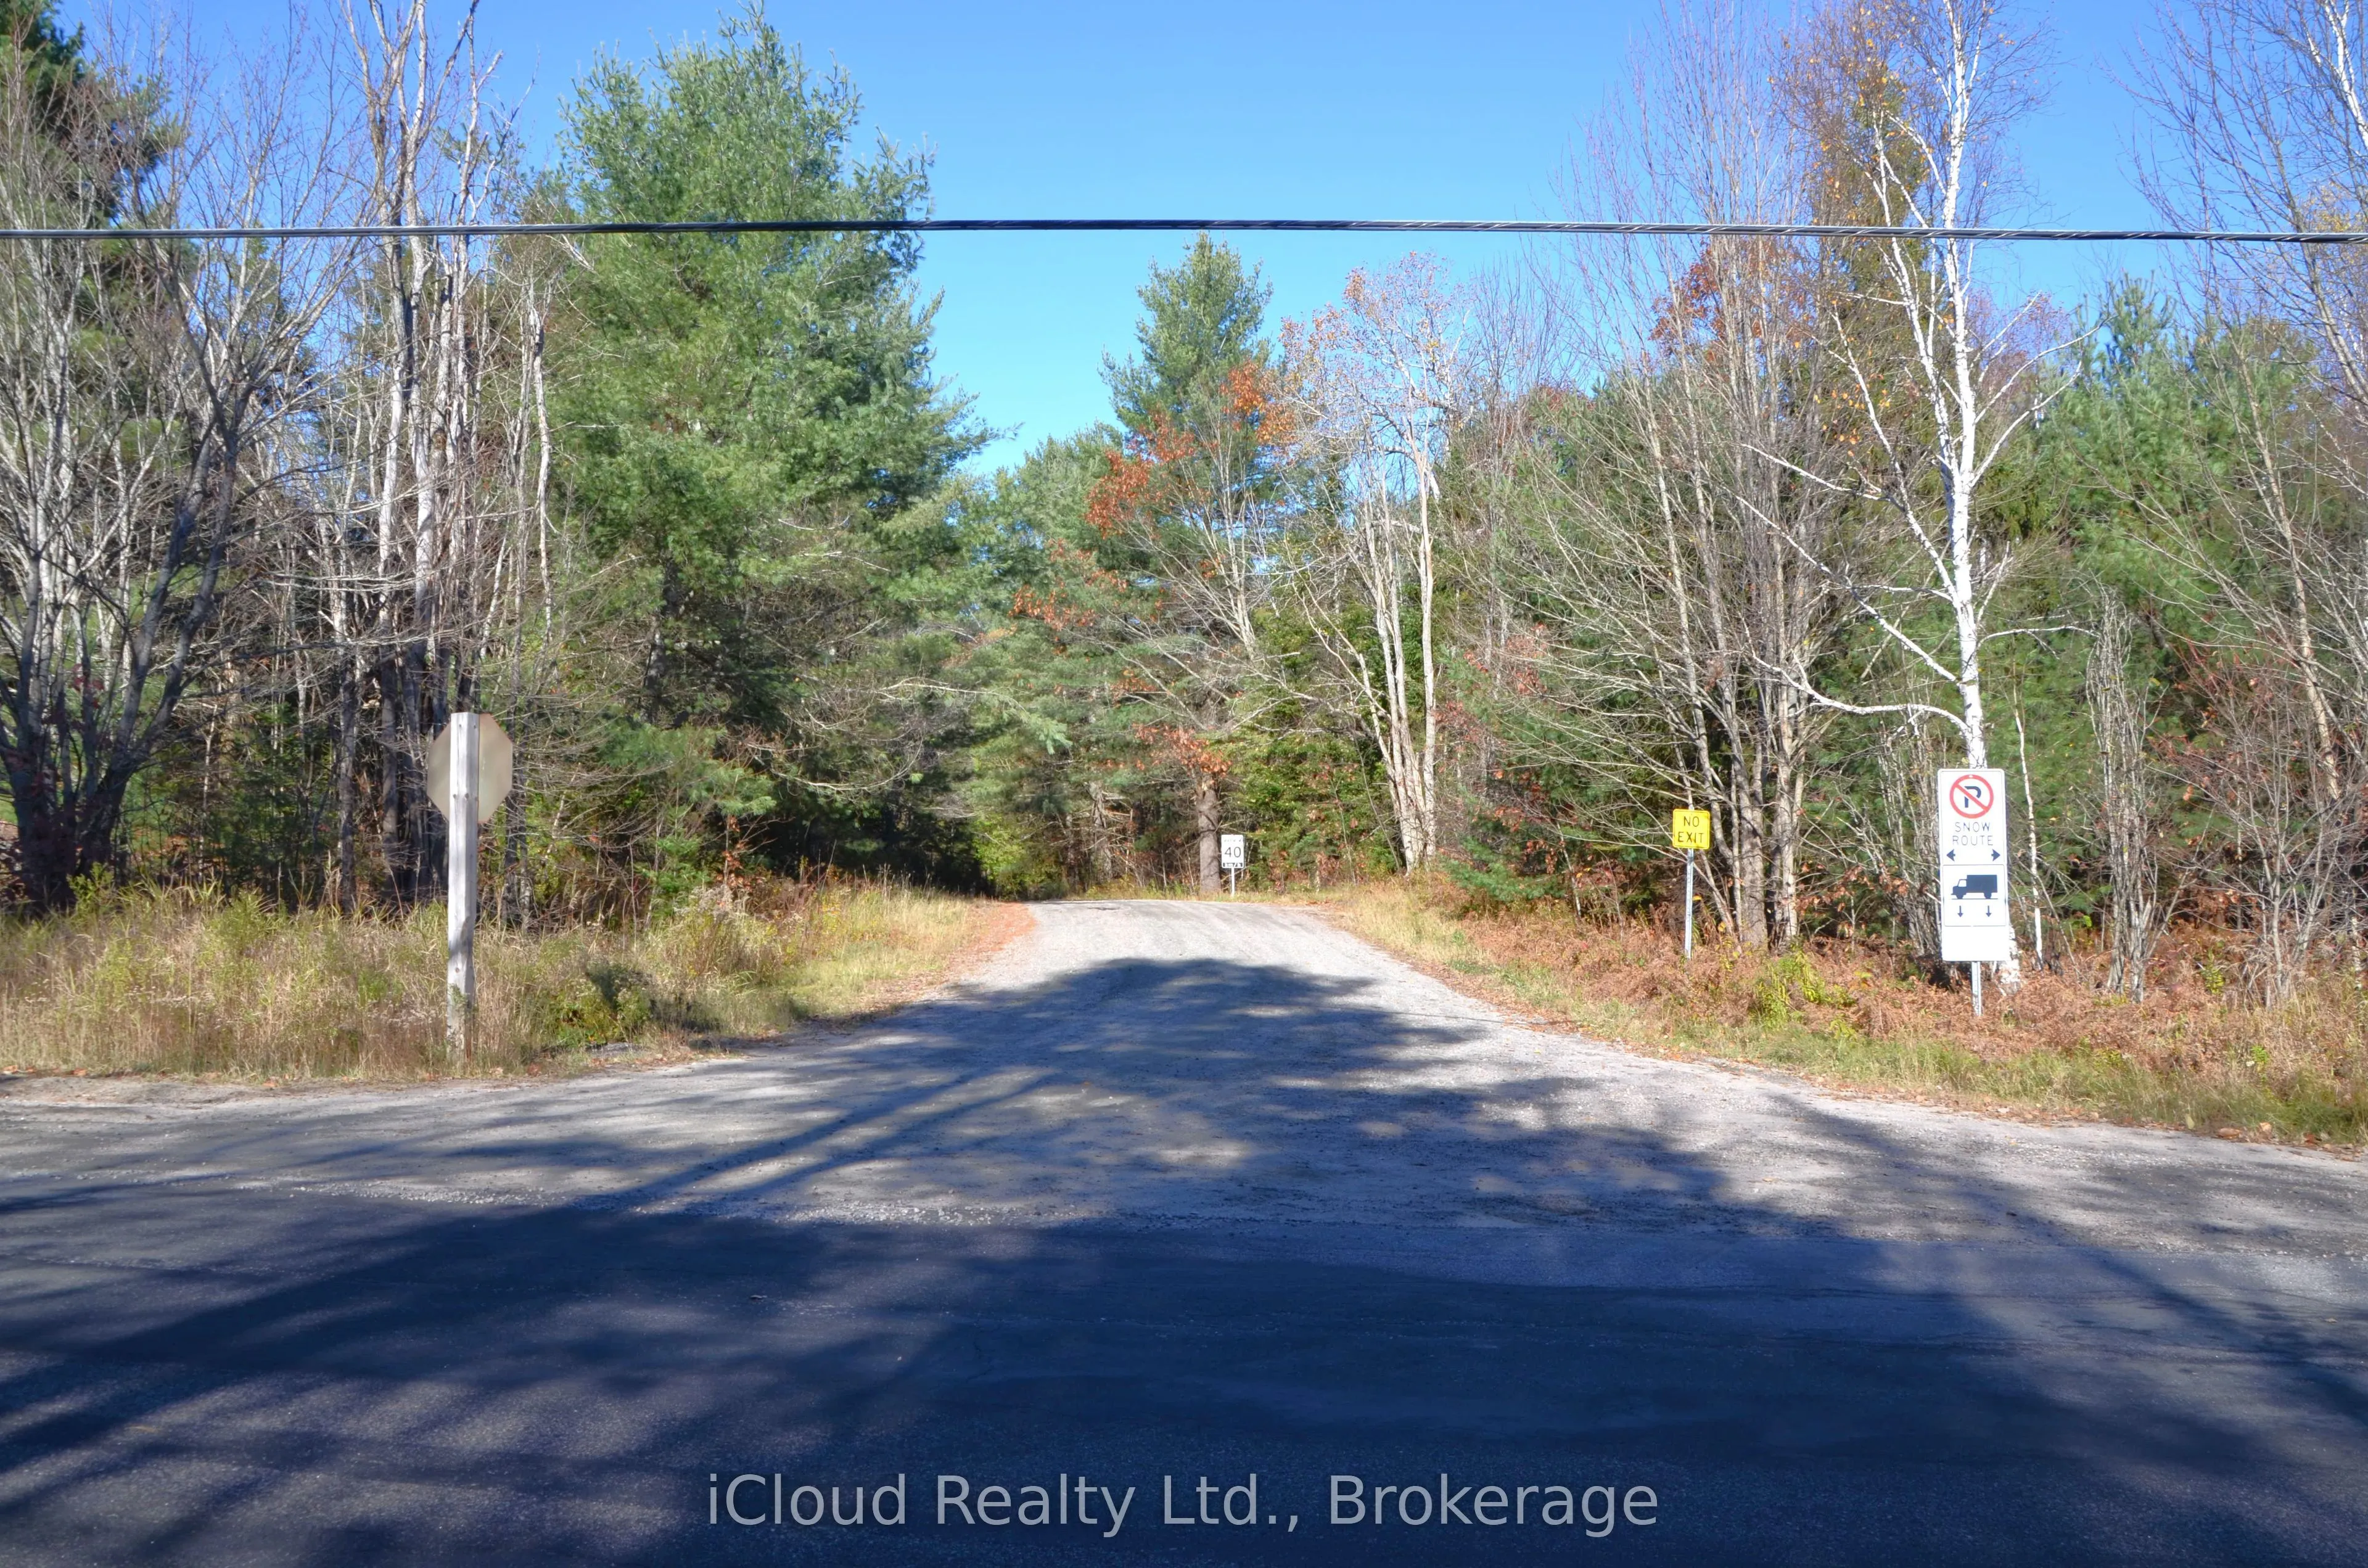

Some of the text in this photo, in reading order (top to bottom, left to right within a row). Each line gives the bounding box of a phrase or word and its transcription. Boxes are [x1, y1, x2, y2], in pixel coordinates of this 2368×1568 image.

[1684, 816, 1700, 827] NO
[1955, 822, 1990, 832] SNOW
[1678, 831, 1704, 844] EXIT
[1952, 835, 1993, 846] ROUTE
[1225, 847, 1241, 858] 40
